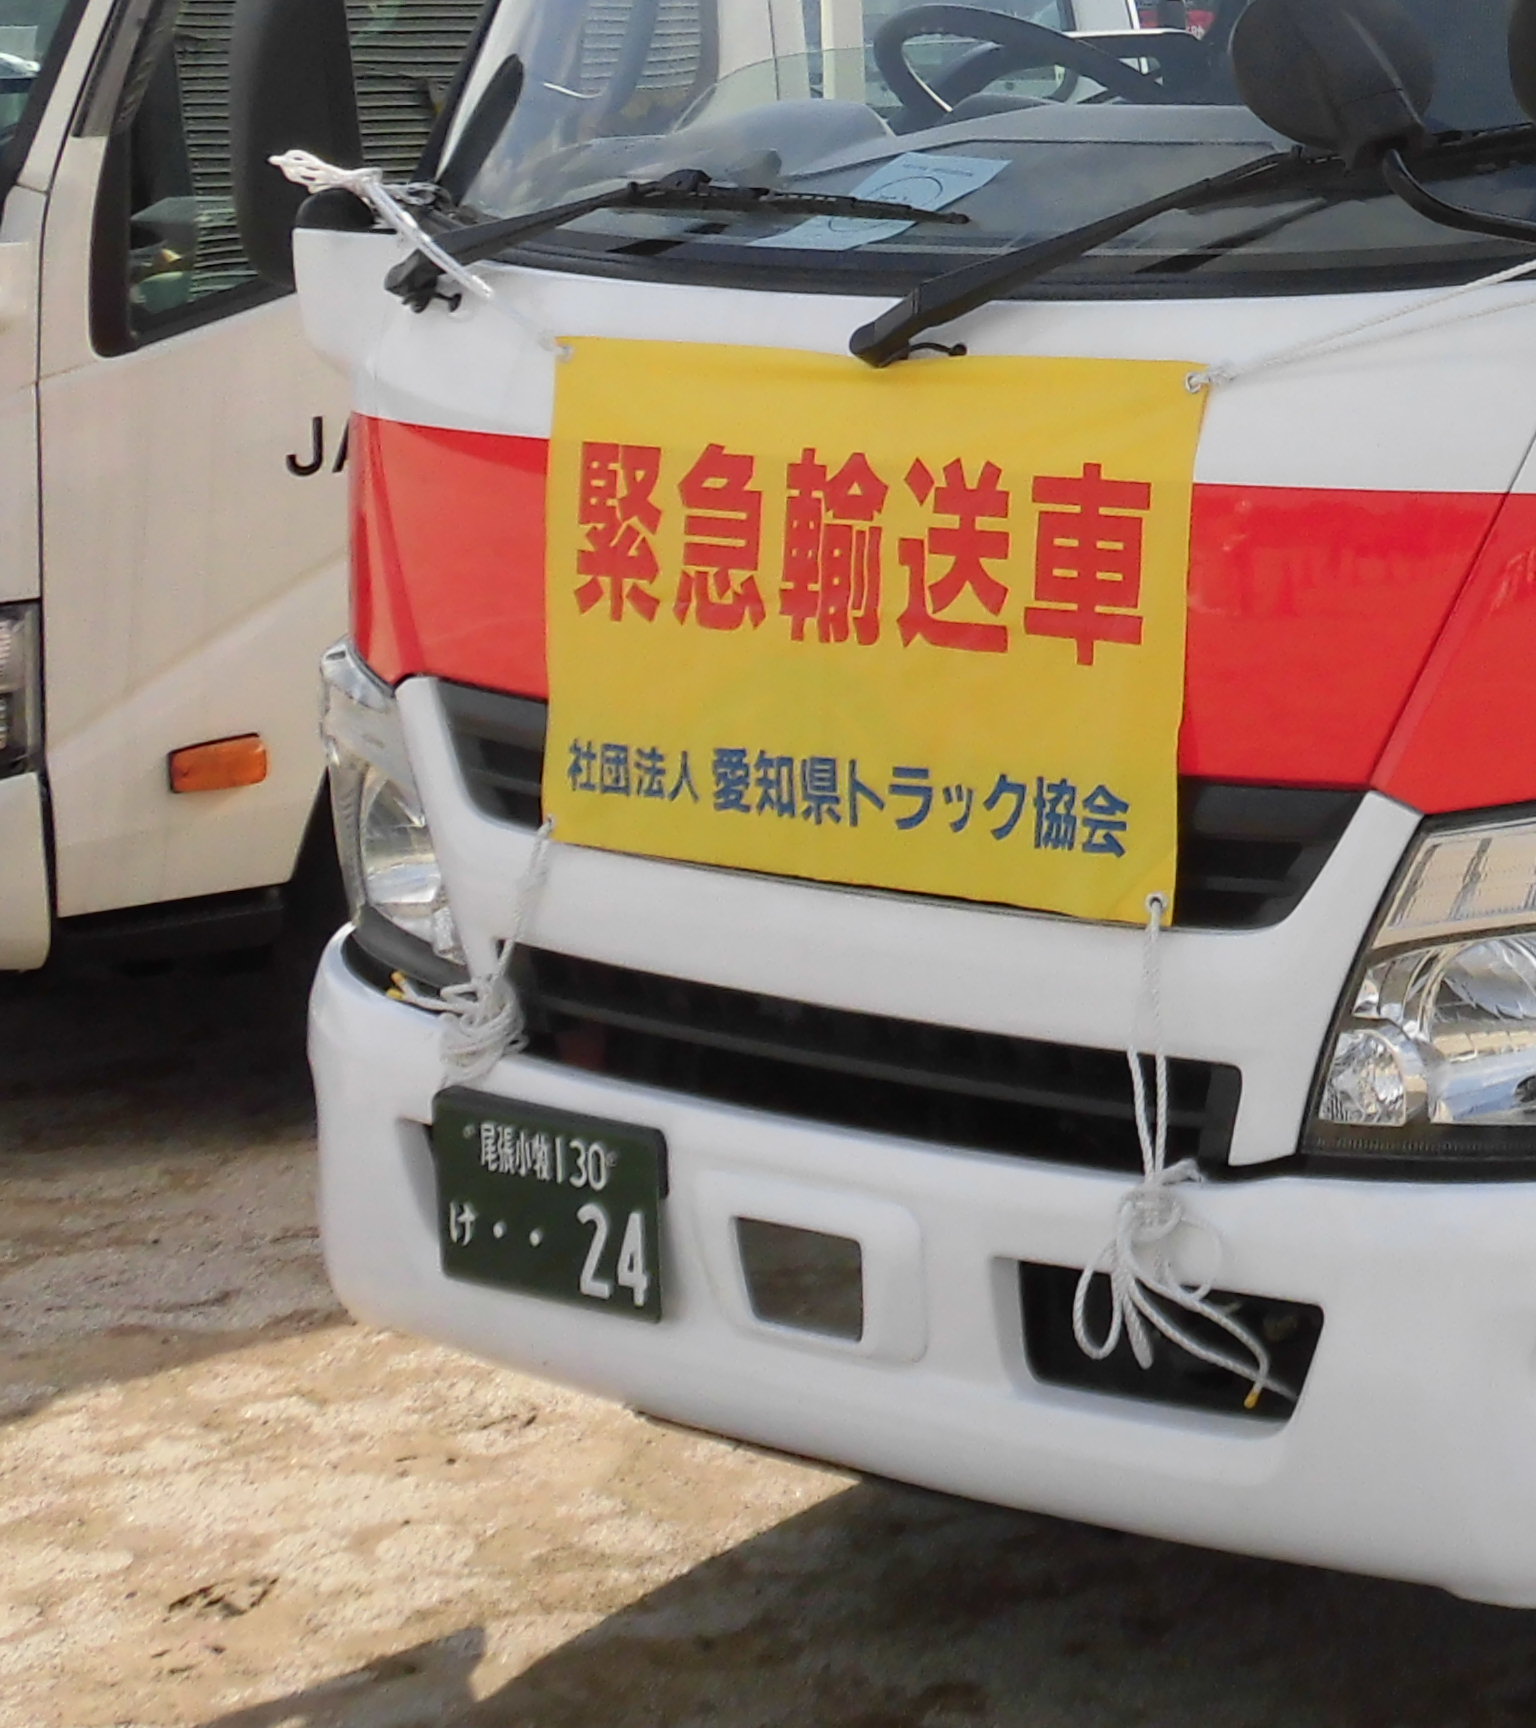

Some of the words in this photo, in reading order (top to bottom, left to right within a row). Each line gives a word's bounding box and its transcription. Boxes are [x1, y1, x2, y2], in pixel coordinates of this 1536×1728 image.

[574, 440, 1152, 666] 緊急輸送車
